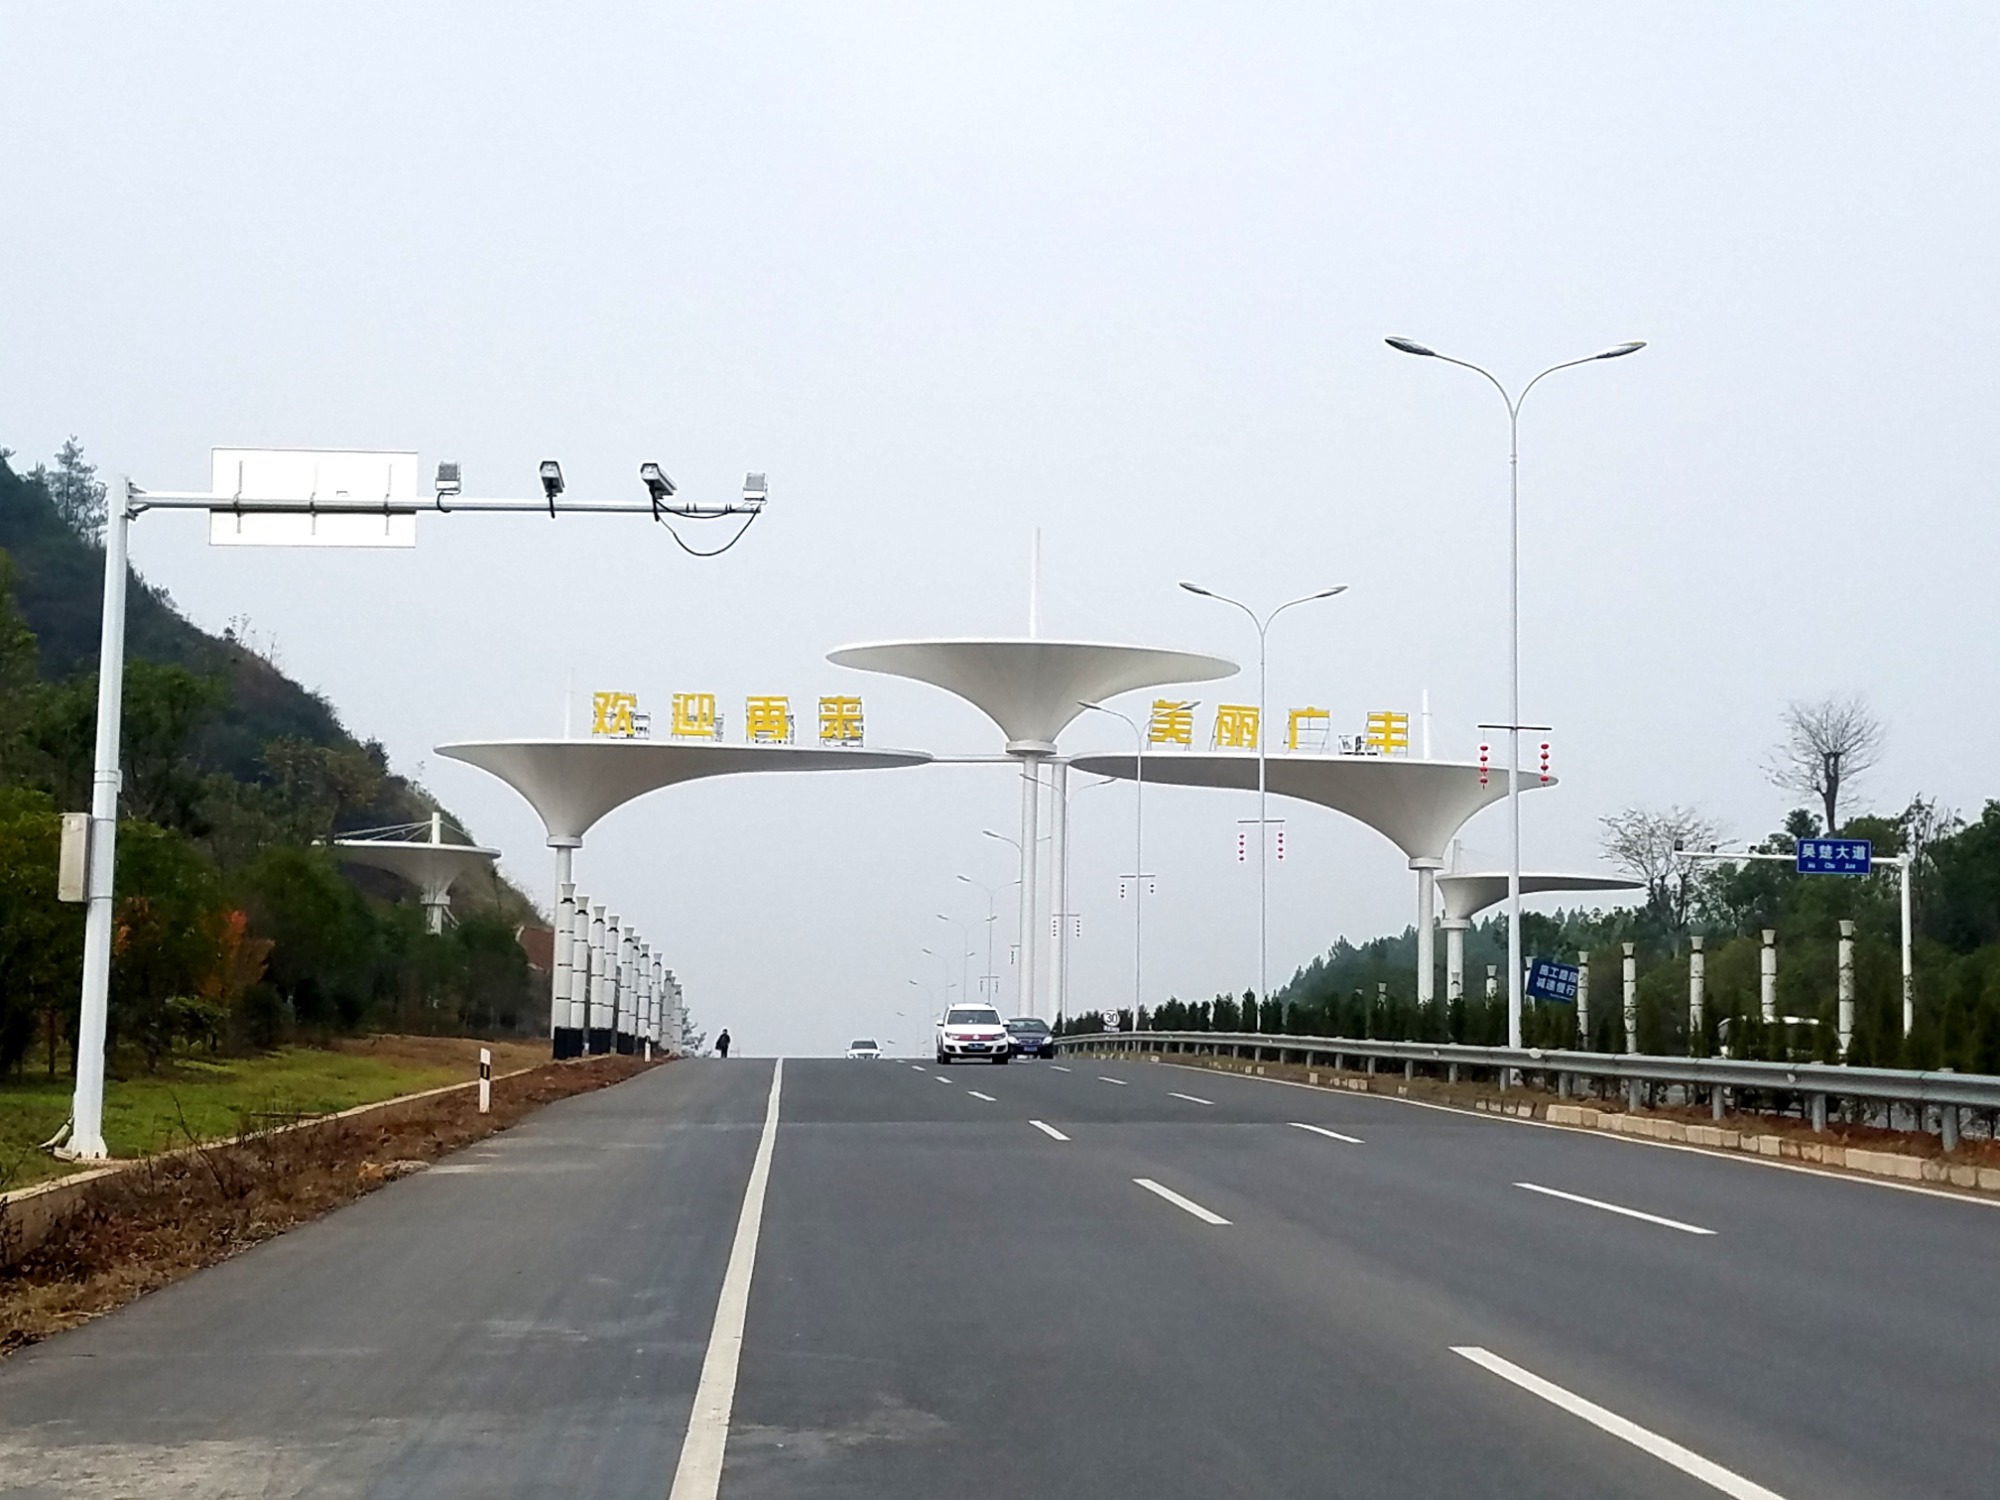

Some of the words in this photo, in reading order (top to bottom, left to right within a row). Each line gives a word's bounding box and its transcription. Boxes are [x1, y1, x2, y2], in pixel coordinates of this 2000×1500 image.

[593, 691, 863, 739] 欢迎再来
[1149, 699, 1408, 753] 美丽广丰
[1802, 843, 1866, 860] 吴楚大道
[1536, 976, 1577, 996] 减速慢行
[1106, 1012, 1118, 1023] 30
